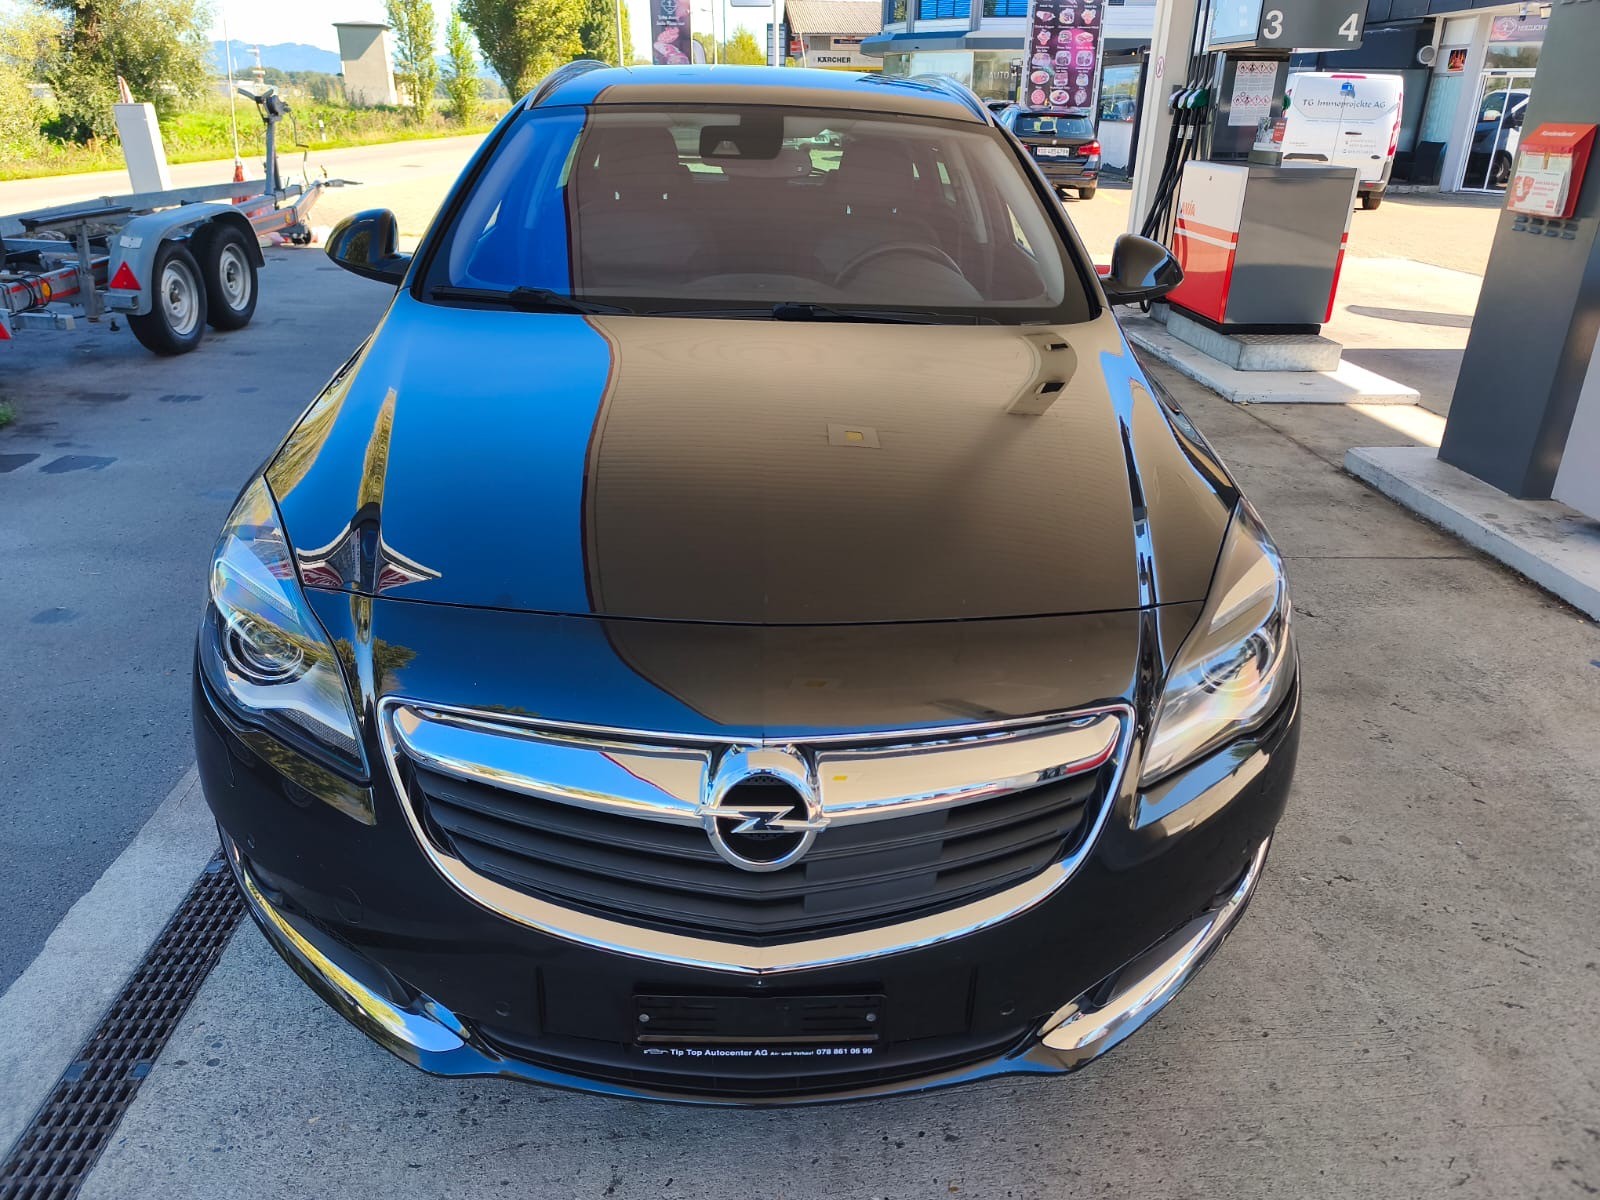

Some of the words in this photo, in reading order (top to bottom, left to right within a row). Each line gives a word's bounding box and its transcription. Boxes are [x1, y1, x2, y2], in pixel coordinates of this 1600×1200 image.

[1263, 10, 1285, 39] 3
[1338, 13, 1360, 41] 4
[670, 1048, 684, 1057] Tip
[686, 1049, 703, 1057] Top
[704, 1049, 753, 1057] Autocenter
